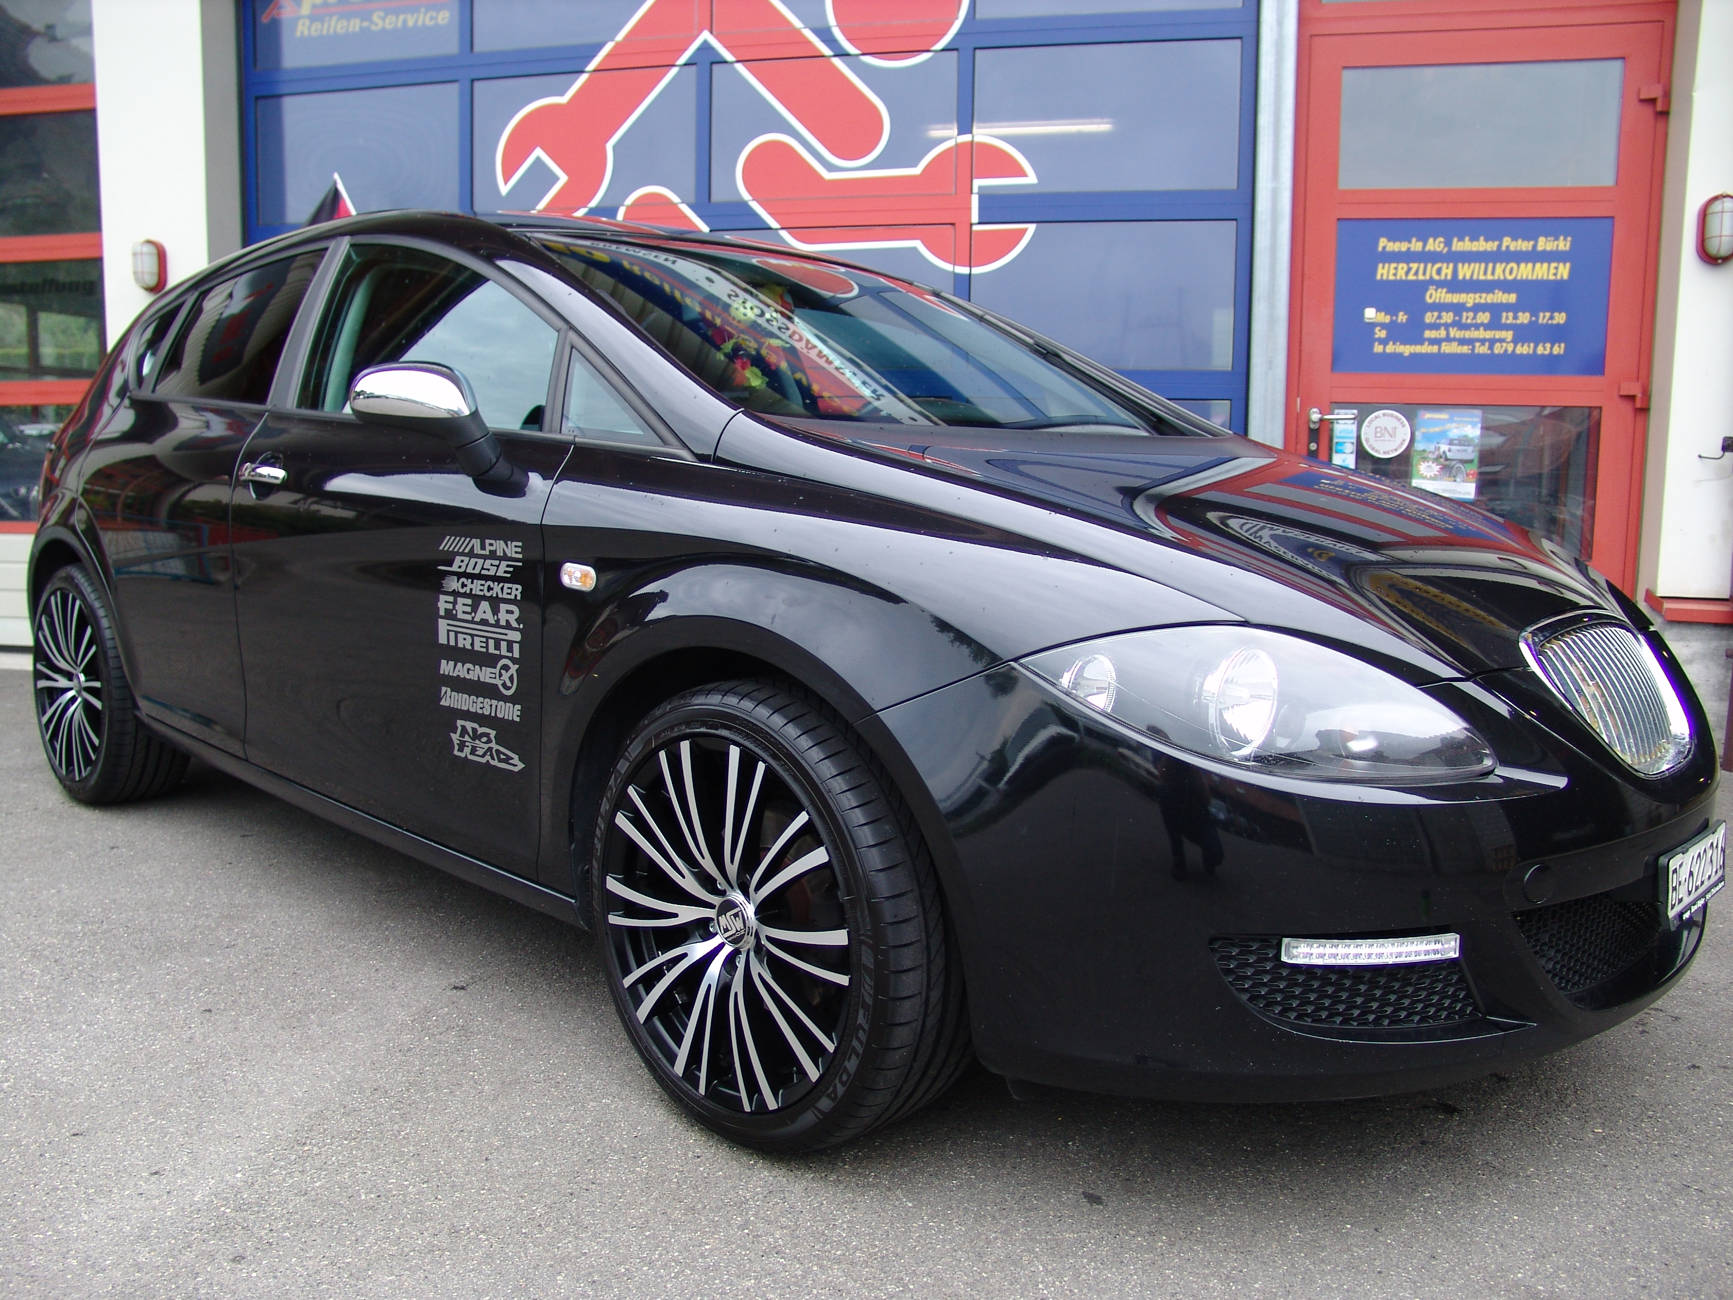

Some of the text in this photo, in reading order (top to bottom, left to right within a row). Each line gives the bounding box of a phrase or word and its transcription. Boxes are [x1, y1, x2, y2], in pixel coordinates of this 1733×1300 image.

[295, 9, 449, 37] Reifen-Service
[1425, 237, 1448, 254] AG,
[1452, 236, 1499, 251] Inhaber
[1501, 236, 1535, 251] Peter
[1537, 236, 1572, 251] Bürki
[1376, 261, 1570, 281] HERZLICH WILLKOMMEN
[1425, 286, 1517, 308] Öffnungszeiten
[1398, 311, 1408, 323] Fr
[1425, 312, 1454, 323] 07.30
[1461, 312, 1490, 323] 12.00
[1501, 312, 1530, 324] 13.30
[1538, 312, 1567, 324] 17.30
[1374, 326, 1513, 342] Sa nach Vereinbarung
[1373, 341, 1566, 356] In dringenden Fällen: Tel. 079 661 63 61
[1374, 425, 1397, 440] BNI
[463, 537, 523, 558] ALPINE
[446, 556, 523, 577] BOSE
[457, 577, 522, 600] CHECKER
[438, 618, 522, 658] PIRELLI
[440, 658, 519, 696] MAGNEX
[440, 686, 522, 721] BRIDGESTONE
[456, 721, 496, 745] NO
[718, 906, 745, 938] MSW
